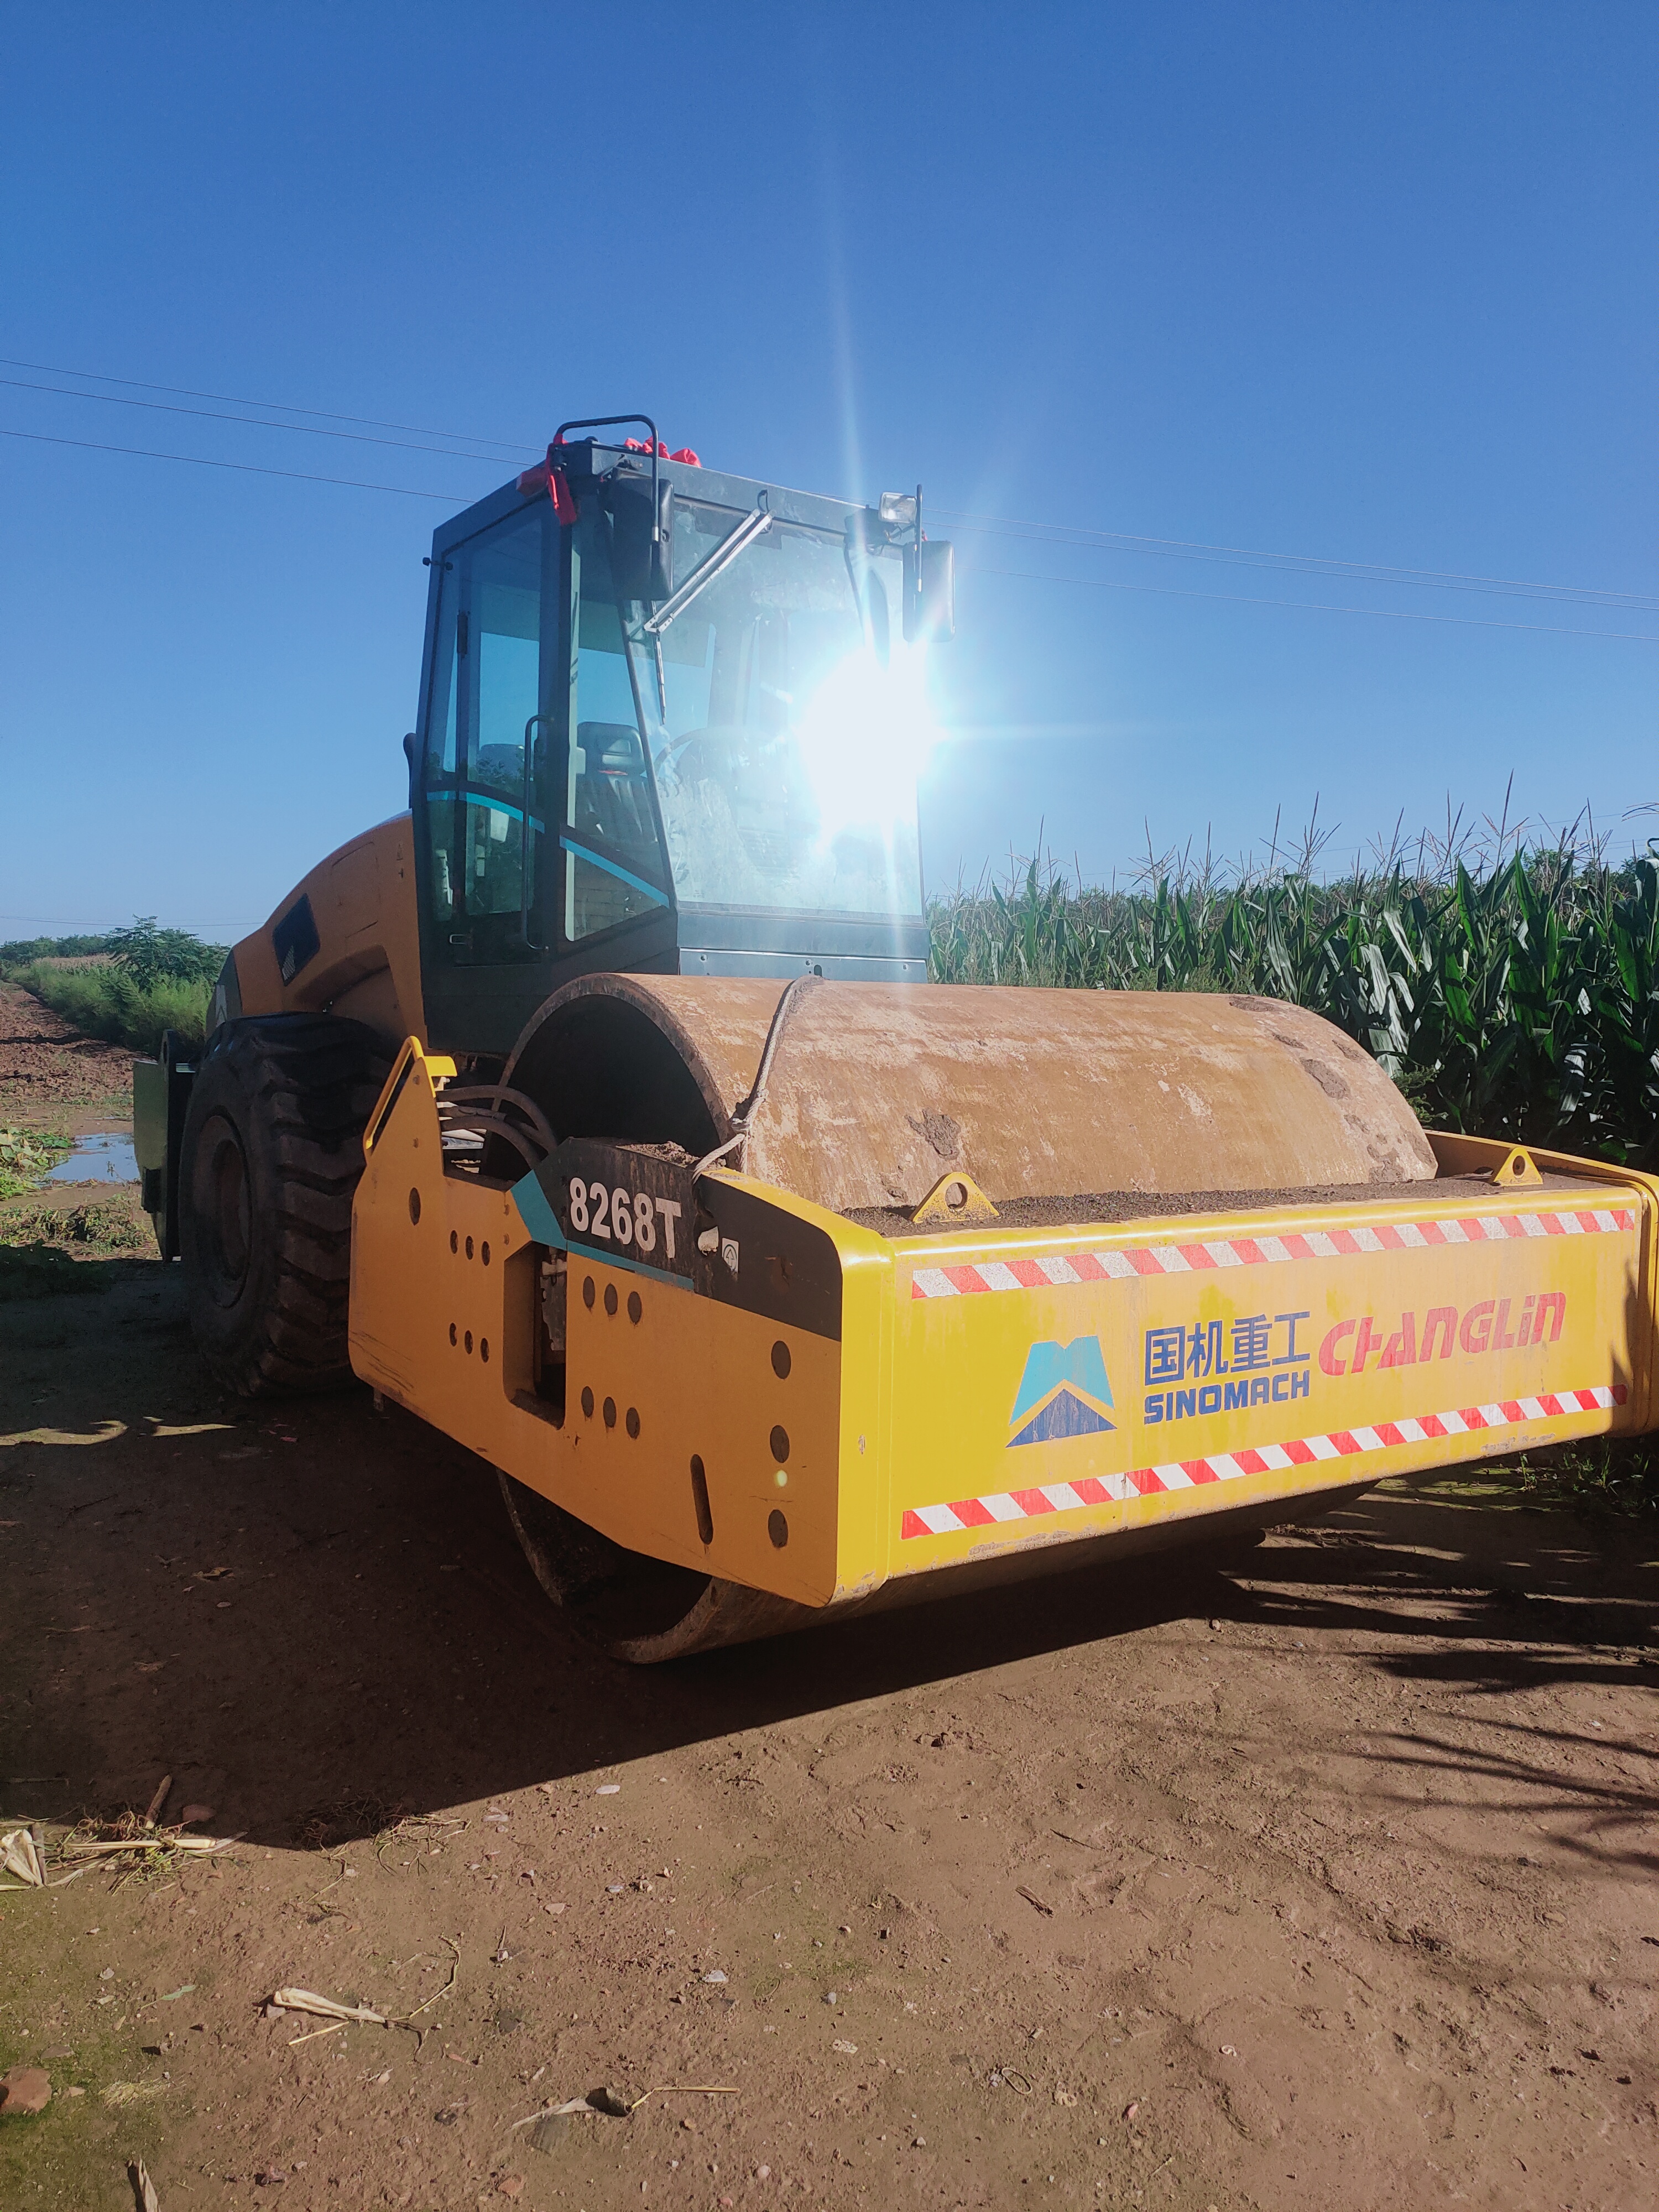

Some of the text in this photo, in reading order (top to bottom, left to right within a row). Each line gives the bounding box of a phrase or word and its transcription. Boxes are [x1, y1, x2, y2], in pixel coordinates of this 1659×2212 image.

[570, 1177, 681, 1258] 8268T
[1145, 1312, 1310, 1386] 国机重工
[1144, 1370, 1310, 1425] SINOMACH
